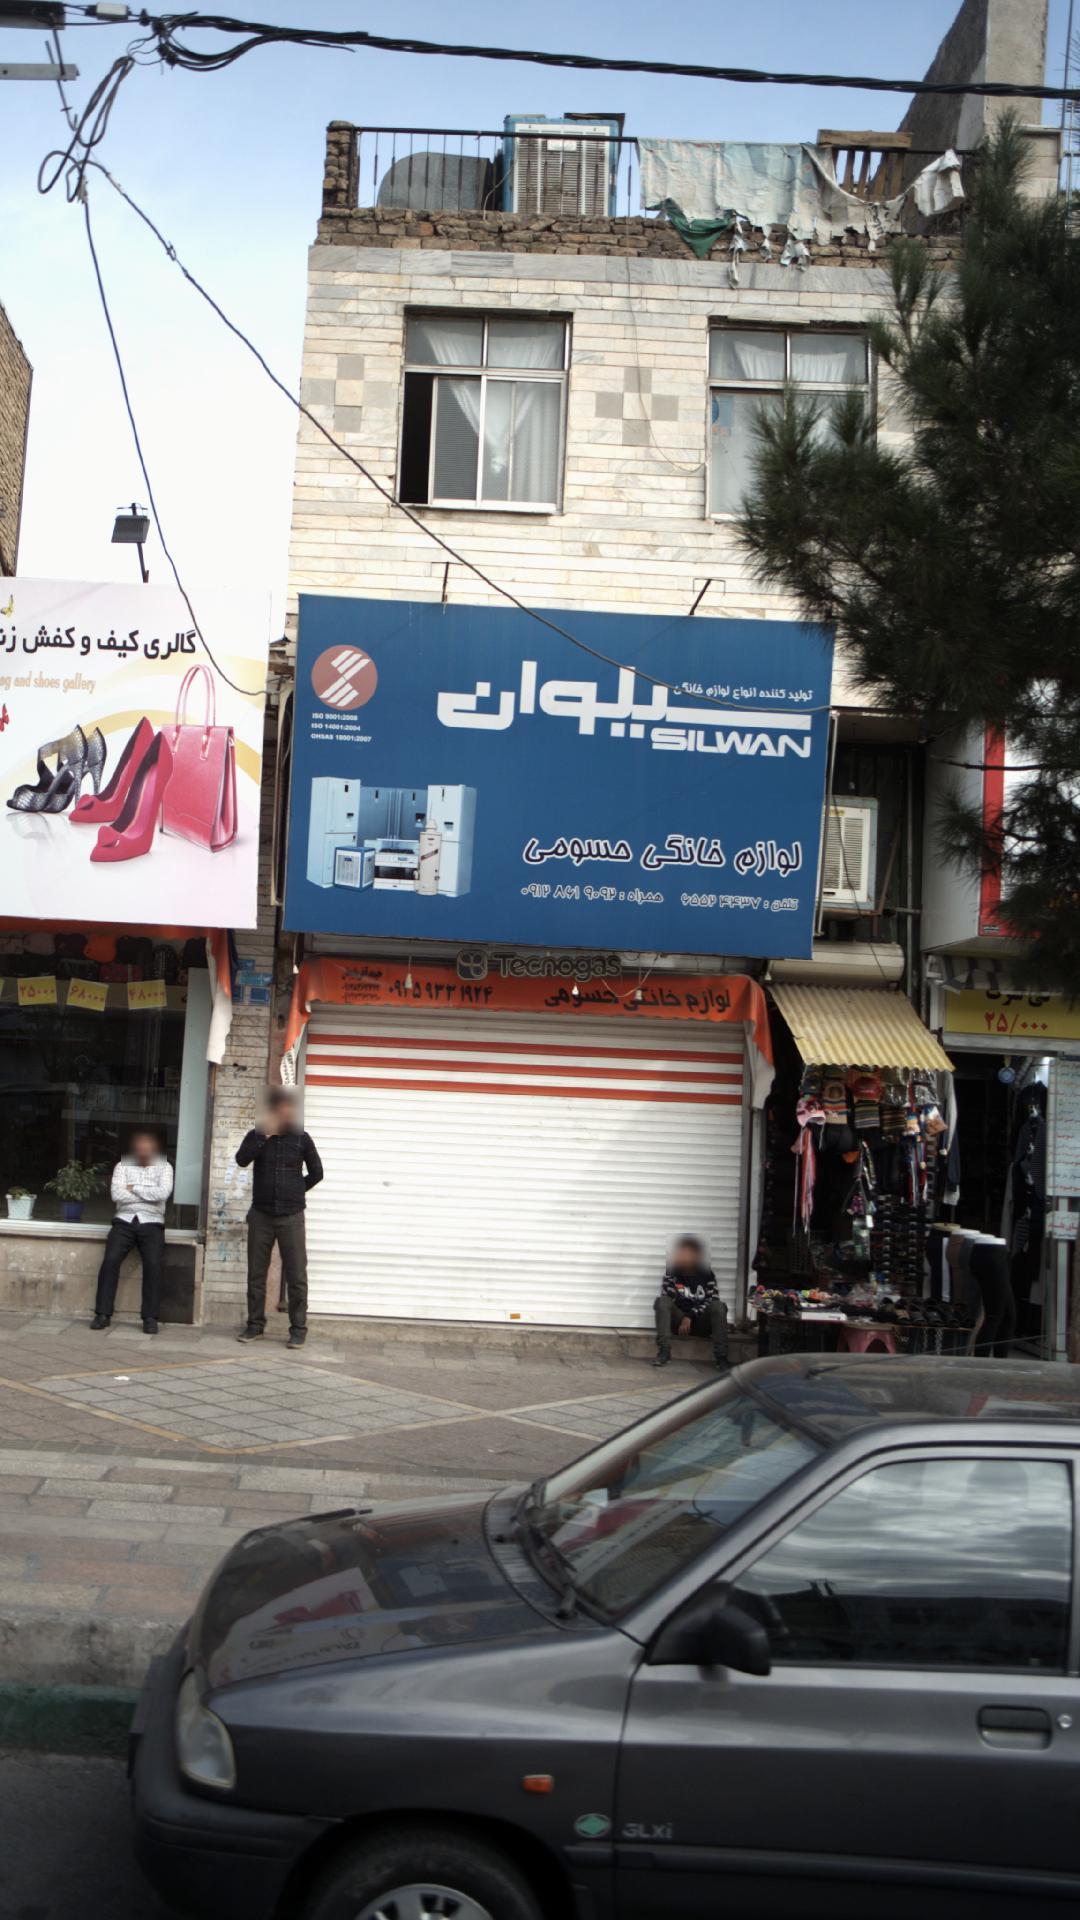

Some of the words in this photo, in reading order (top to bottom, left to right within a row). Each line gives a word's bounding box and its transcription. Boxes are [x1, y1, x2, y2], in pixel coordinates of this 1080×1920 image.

[23, 625, 76, 654] کفش
[80, 635, 91, 656] و
[97, 629, 139, 659] کیف
[144, 628, 197, 660] گالری
[14, 670, 32, 688] and
[33, 670, 60, 689] shoes
[62, 671, 96, 694] gallery
[705, 684, 730, 698] لوازم
[732, 686, 757, 700] انواع
[758, 688, 786, 699] کننده
[788, 689, 814, 702] تولید
[437, 659, 812, 739] سیلوان
[311, 712, 324, 720] ISO
[650, 727, 812, 758] SILWAN
[640, 834, 726, 871] خانگی
[734, 840, 802, 878] لوازم
[491, 951, 623, 983] Tecnogas
[685, 988, 732, 1014] لوازم
